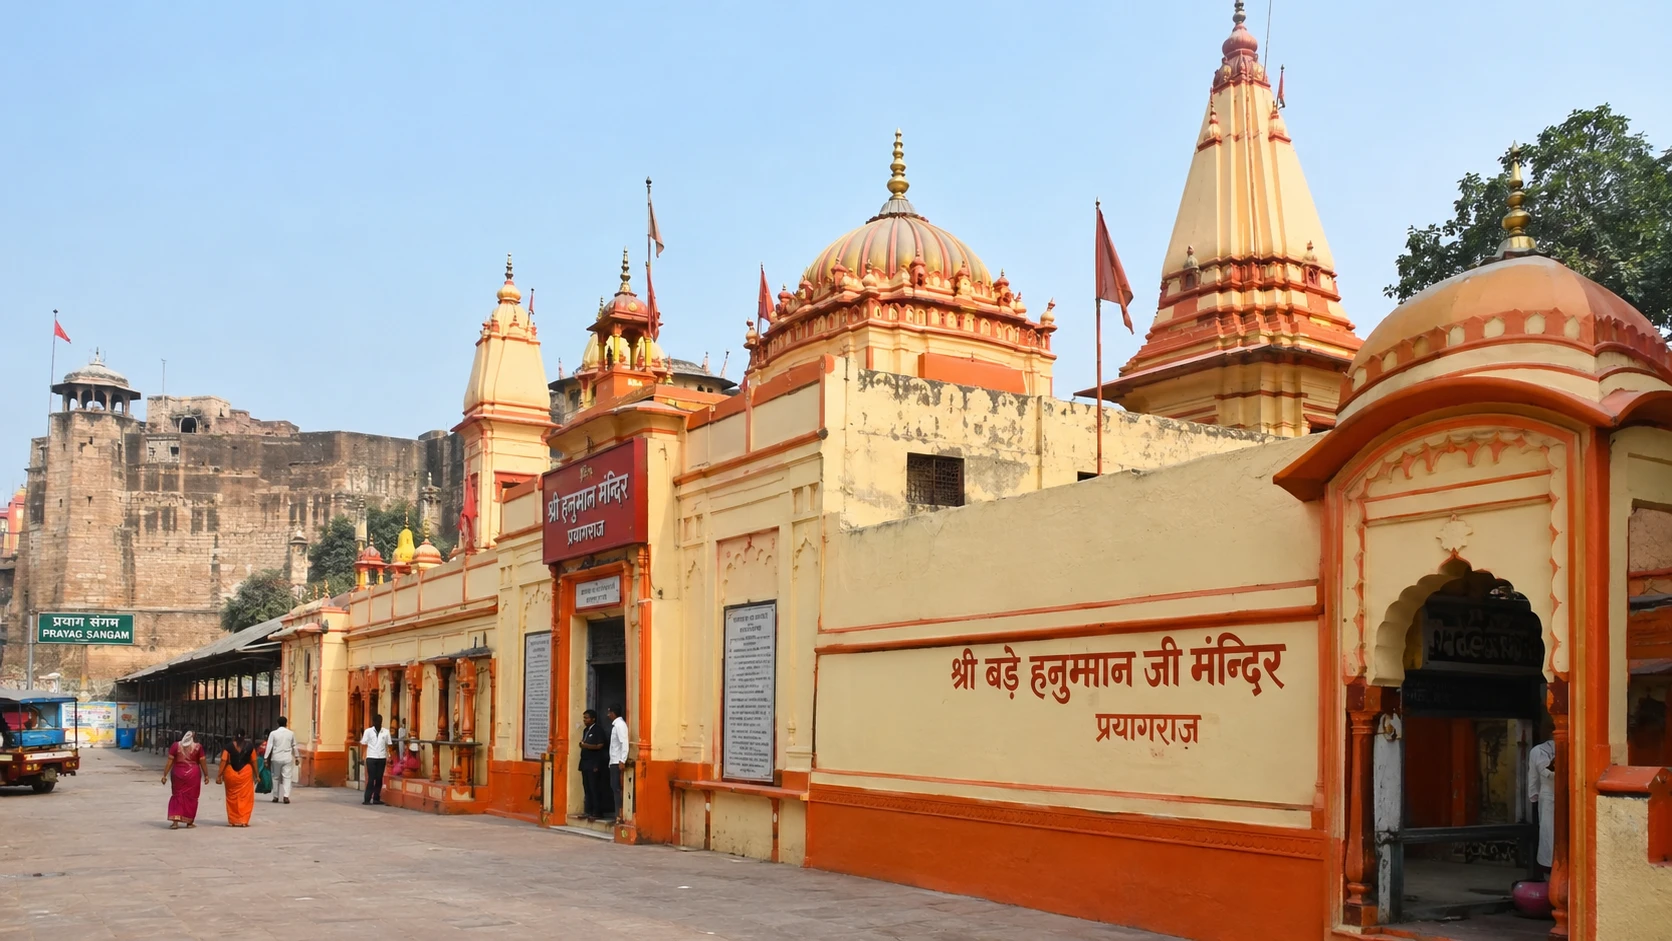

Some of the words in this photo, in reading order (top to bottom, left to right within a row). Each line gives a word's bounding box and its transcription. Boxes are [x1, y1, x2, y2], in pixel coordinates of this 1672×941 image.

[548, 492, 561, 523] श्री
[52, 616, 85, 627] प्रयाग
[89, 615, 120, 628] संगम
[42, 629, 83, 638] PRAYAG
[86, 630, 130, 640] SANGAM
[951, 647, 979, 690] श्री
[984, 644, 1022, 700] बड़े
[1142, 635, 1184, 688] जी
